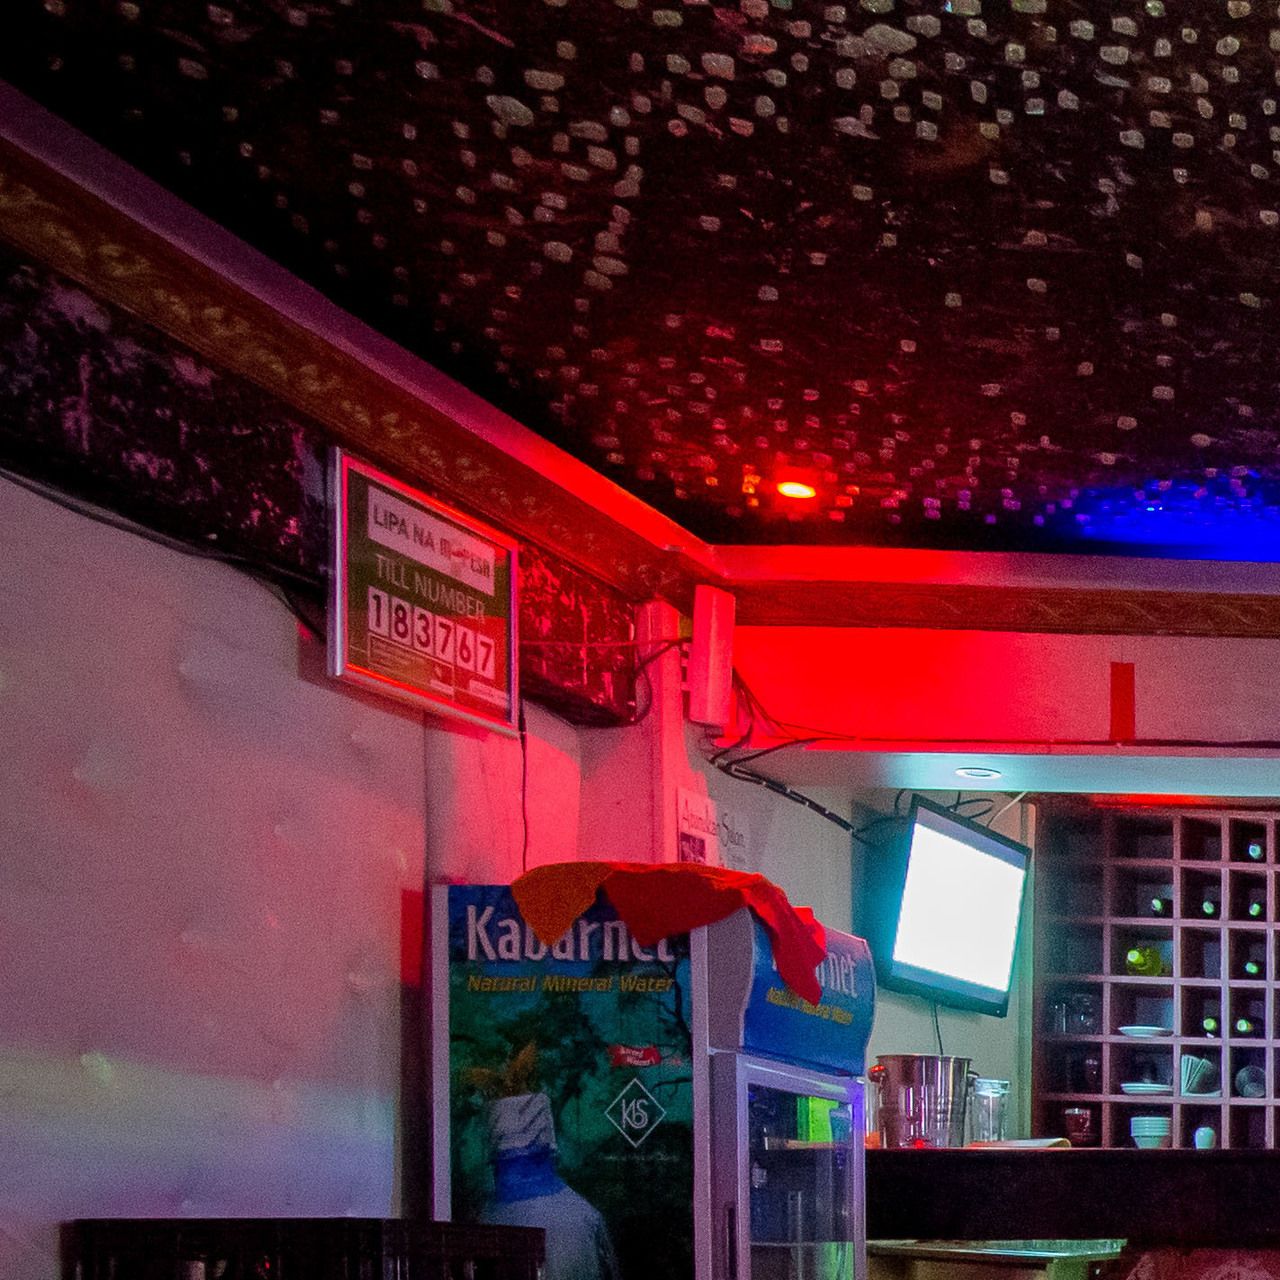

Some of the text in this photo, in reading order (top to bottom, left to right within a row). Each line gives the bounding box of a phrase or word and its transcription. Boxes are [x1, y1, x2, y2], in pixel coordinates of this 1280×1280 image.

[372, 503, 409, 541] LIPA
[413, 523, 435, 553] NA
[375, 553, 486, 625] TILL NUMBER
[371, 593, 493, 673] 183767
[467, 975, 675, 992] Natural Mineral Water
